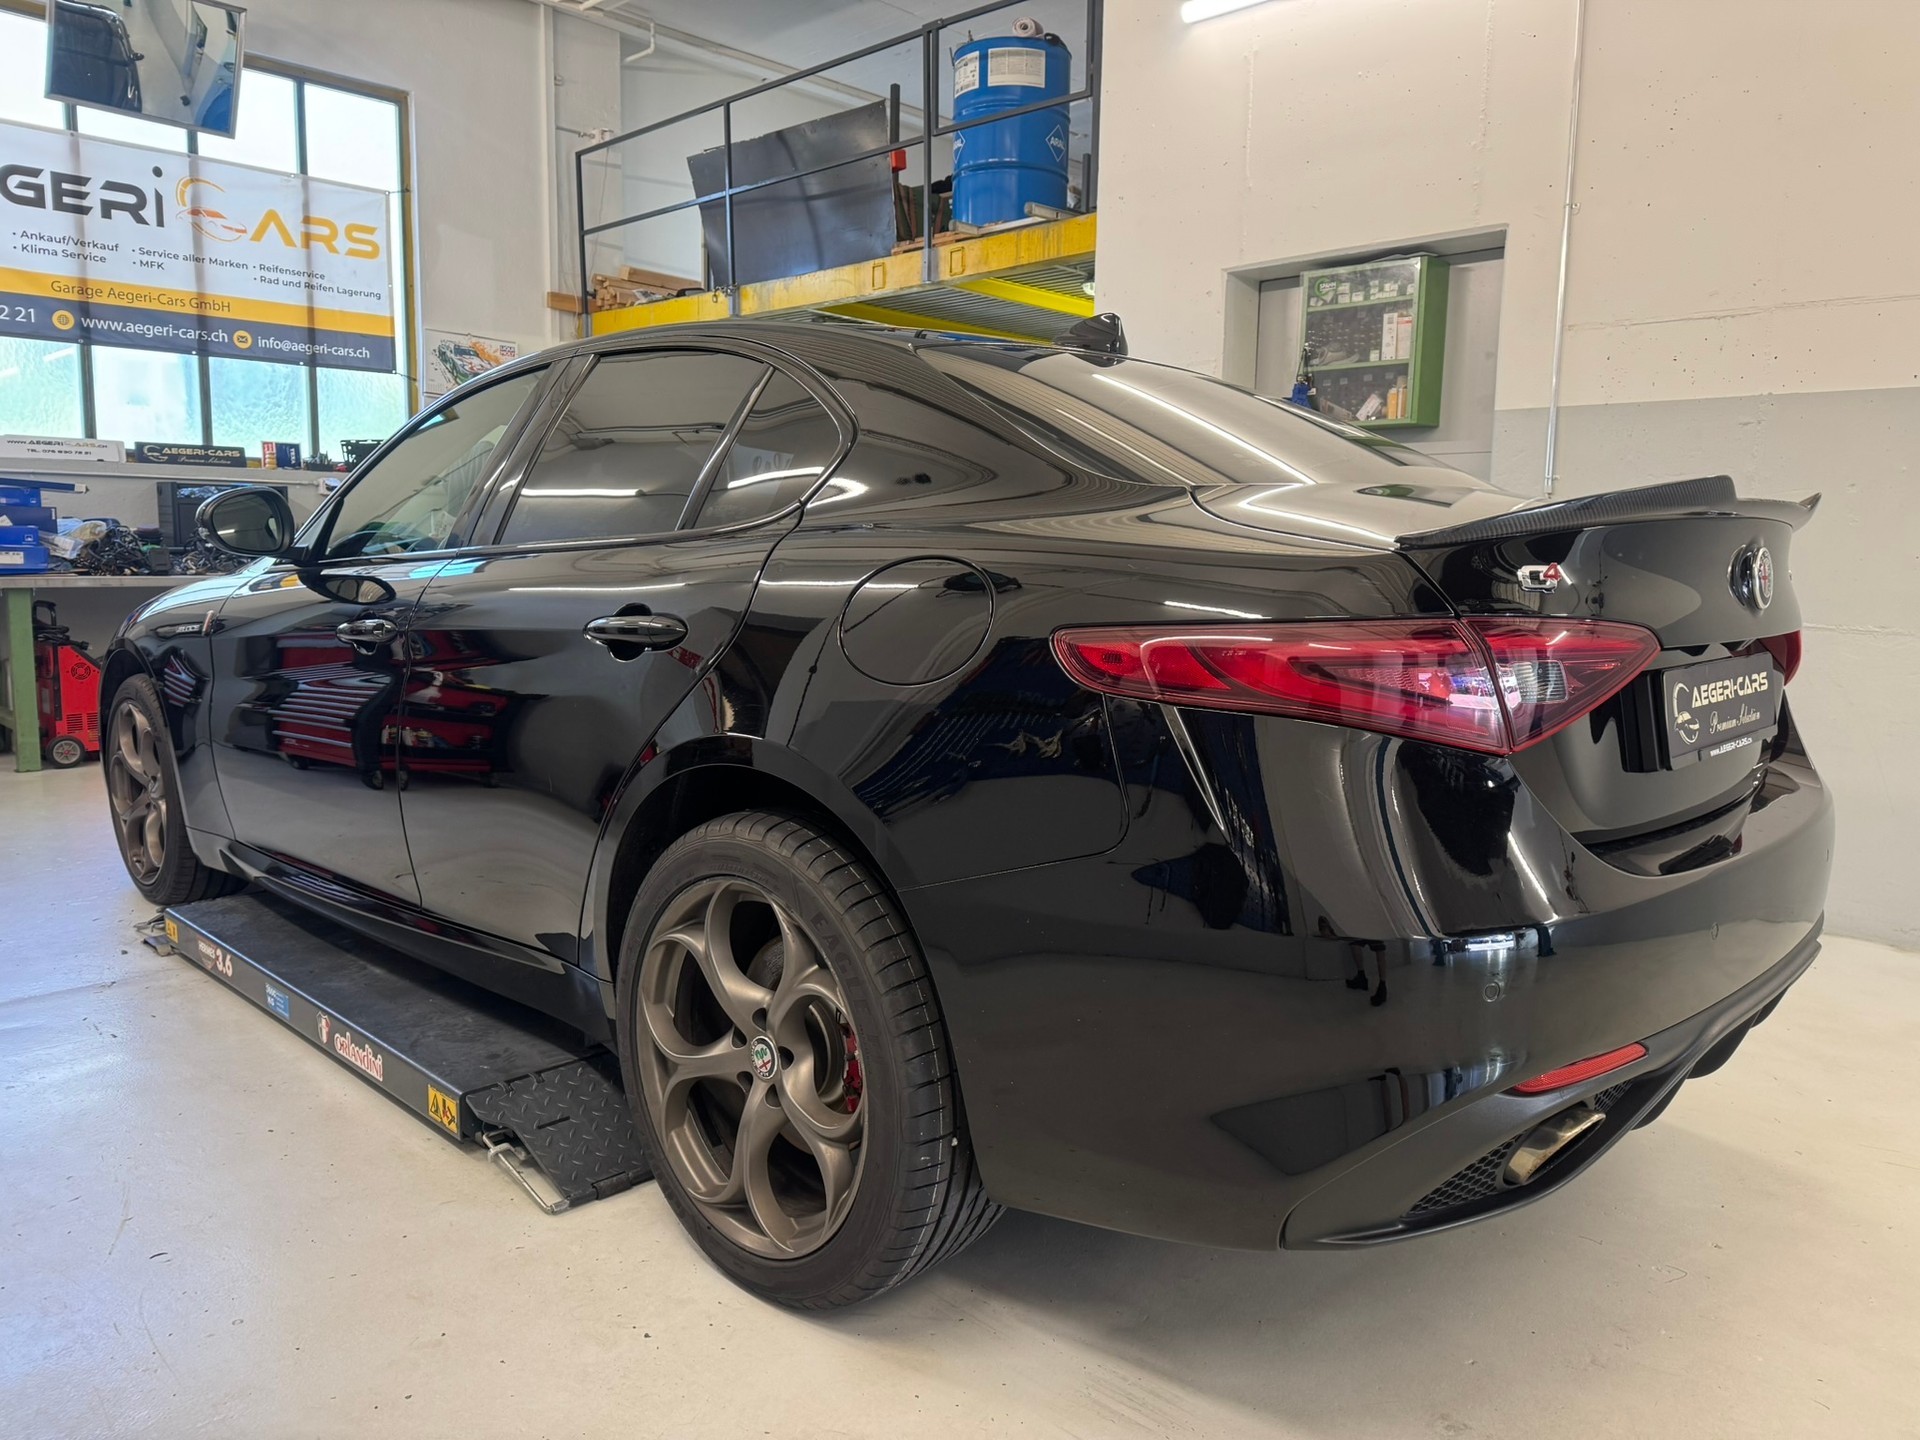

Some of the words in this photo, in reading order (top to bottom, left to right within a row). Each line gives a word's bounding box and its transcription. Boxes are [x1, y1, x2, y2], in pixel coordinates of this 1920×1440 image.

[20, 230, 119, 252] Ankauf/Verkauf
[20, 243, 58, 257] Klima
[61, 249, 107, 264] Service
[138, 246, 180, 261] Service
[182, 253, 206, 264] aller
[208, 257, 249, 271] Marken
[139, 259, 165, 271] MFK
[259, 263, 326, 281] Reifenservice
[50, 280, 104, 299] Garage
[106, 286, 186, 308] Aegeri-Cars
[188, 297, 231, 313] GmbH
[260, 275, 280, 286] Rad
[281, 277, 302, 289] und
[304, 281, 335, 294] Reifen
[336, 286, 382, 301] Lagerung
[14, 306, 36, 323] 21
[80, 316, 228, 343] www.aegeri-cars.ch
[257, 335, 371, 359] info@aegeri-cars.ch
[161, 446, 241, 458] AEGERI-CARS
[1516, 562, 1563, 593] Q4
[1691, 671, 1769, 708] AEGERI-CARS
[1709, 710, 1737, 735] Premium
[215, 947, 233, 978] 3.6
